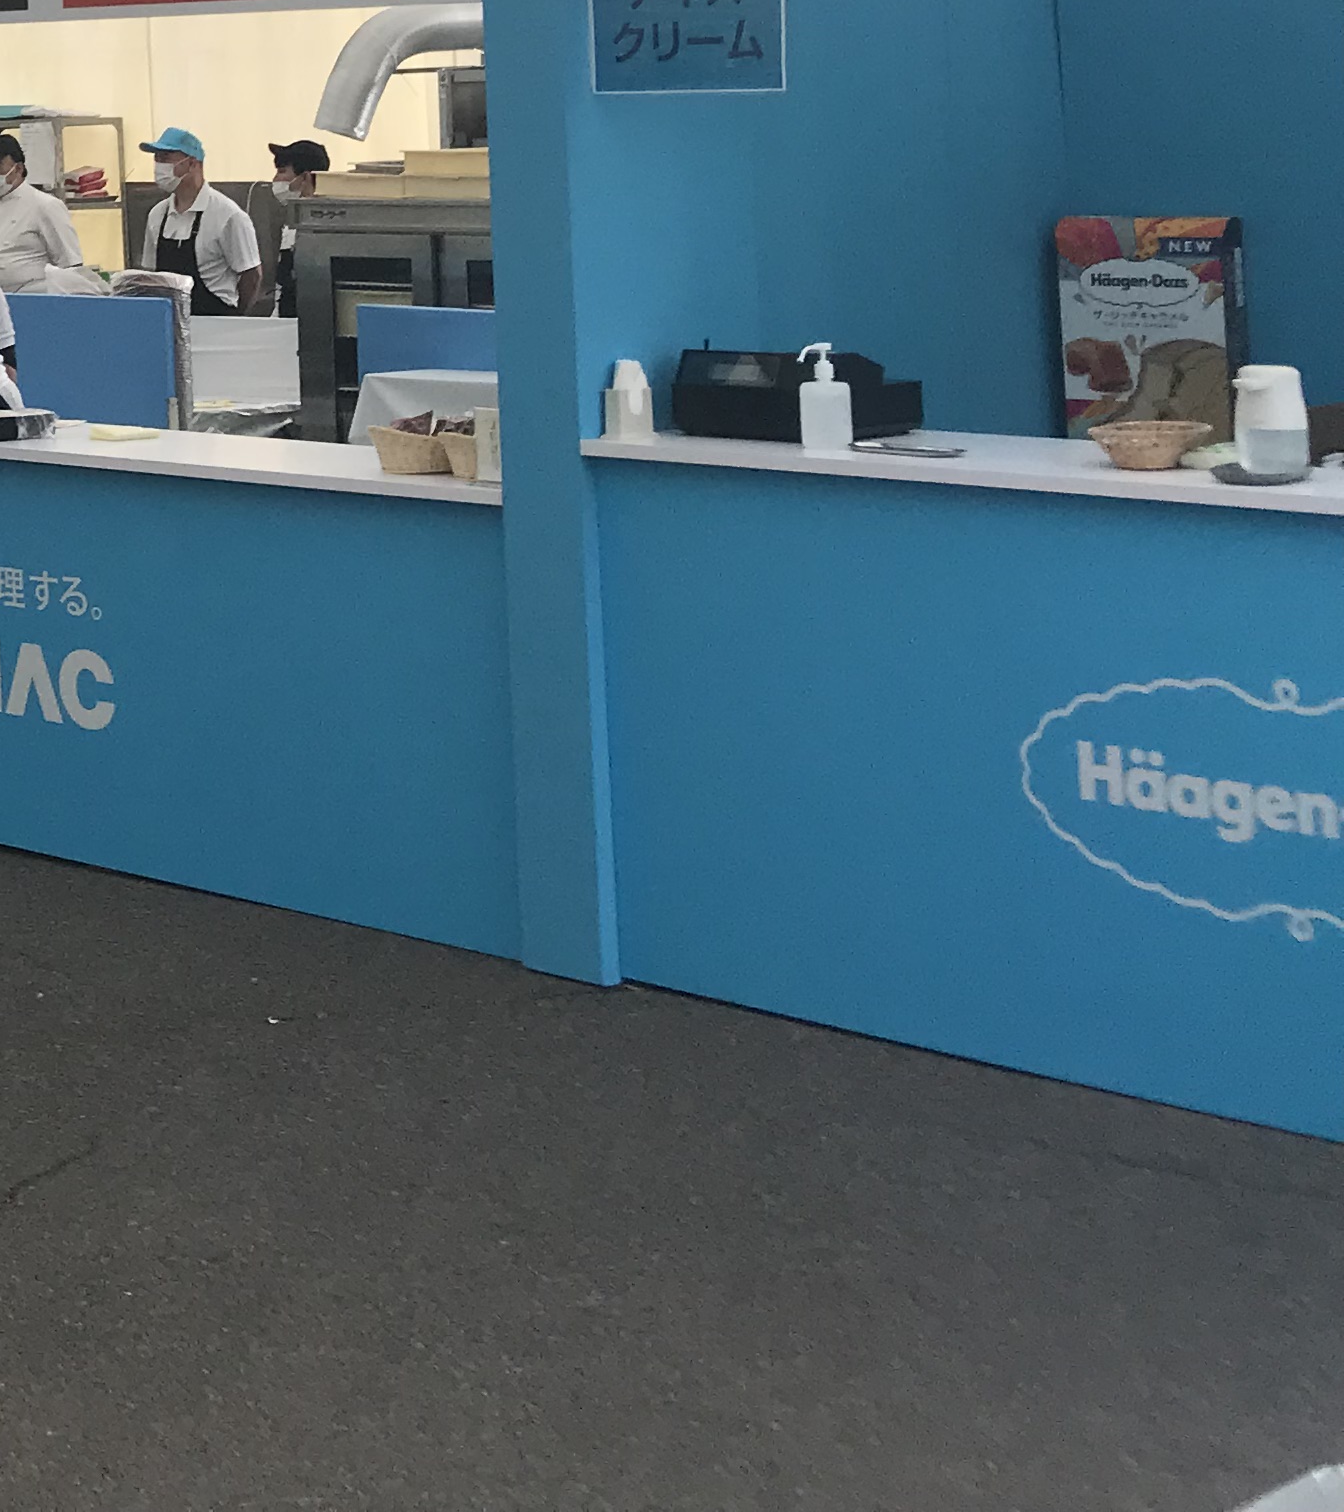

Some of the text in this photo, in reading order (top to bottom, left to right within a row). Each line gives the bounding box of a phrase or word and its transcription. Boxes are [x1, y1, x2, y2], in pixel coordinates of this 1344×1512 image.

[613, 19, 765, 63] クリーム
[1168, 240, 1212, 253] NEW
[1076, 739, 1344, 844] Häagen
